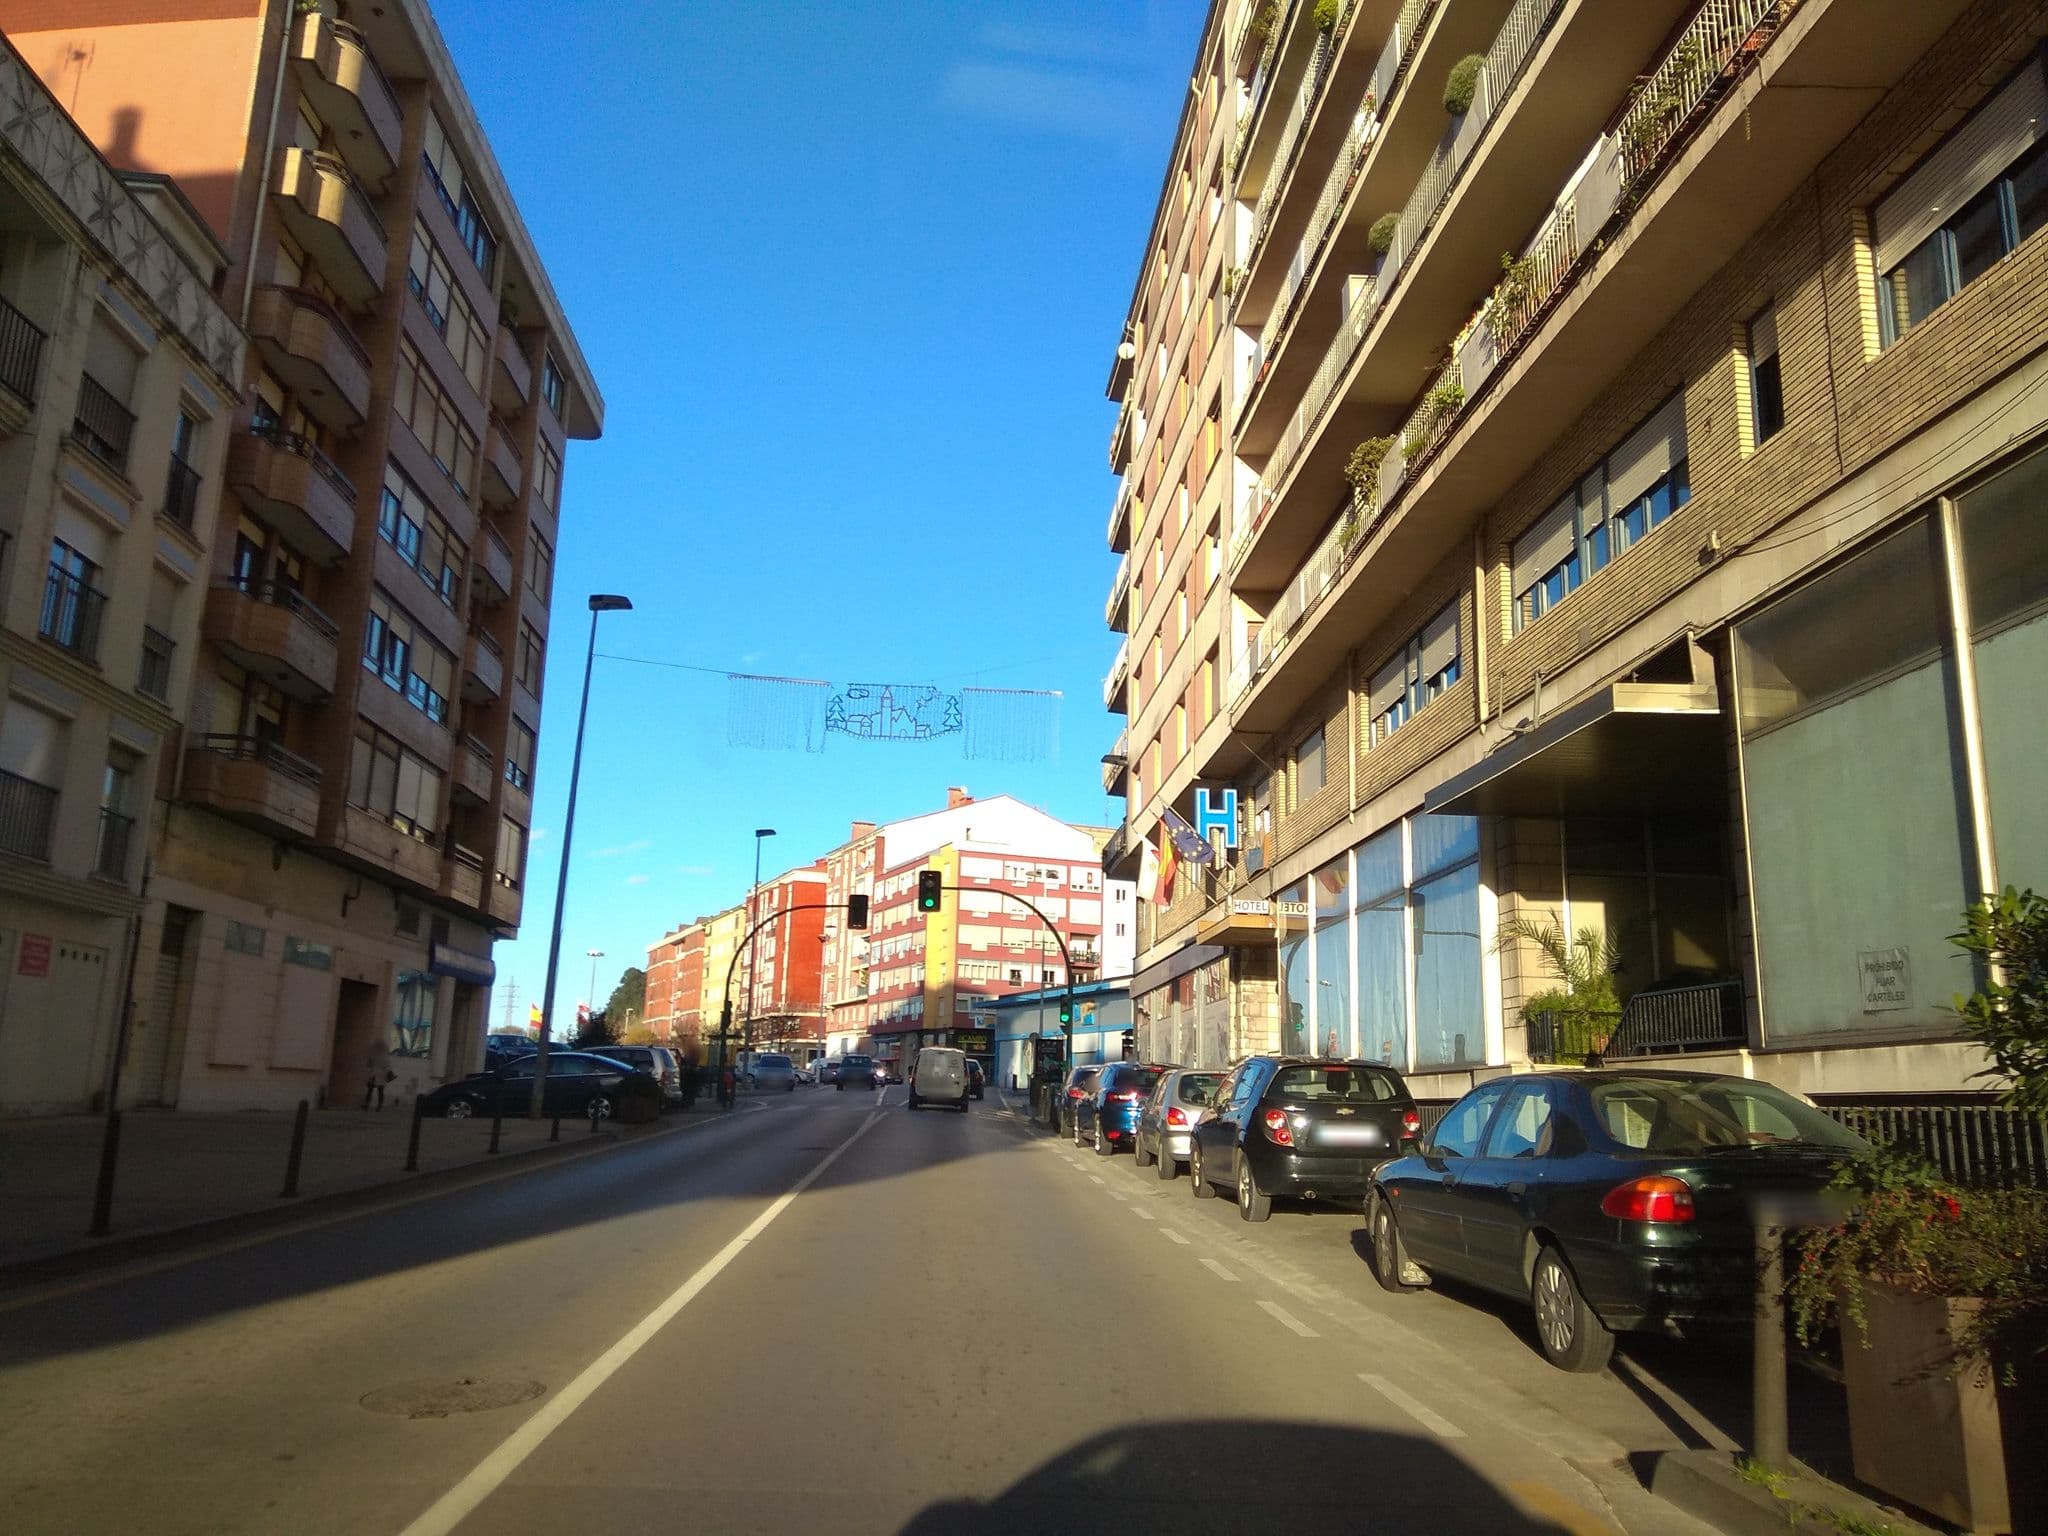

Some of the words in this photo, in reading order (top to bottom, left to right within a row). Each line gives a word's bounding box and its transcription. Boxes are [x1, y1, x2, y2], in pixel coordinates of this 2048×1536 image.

[1195, 788, 1237, 848] H
[1234, 901, 1268, 911] HOTEL
[1867, 991, 1905, 1002] CARTELES
